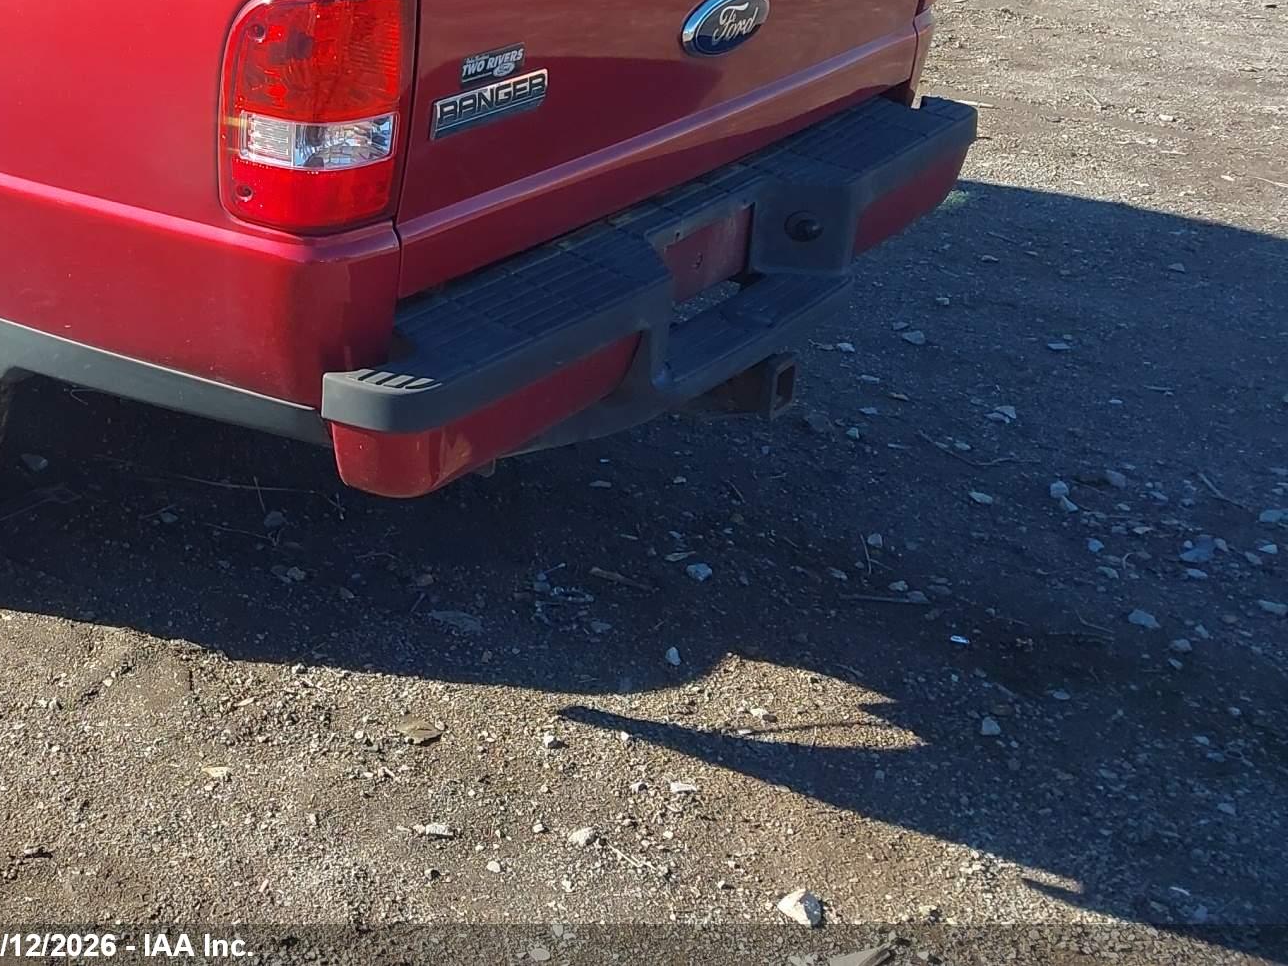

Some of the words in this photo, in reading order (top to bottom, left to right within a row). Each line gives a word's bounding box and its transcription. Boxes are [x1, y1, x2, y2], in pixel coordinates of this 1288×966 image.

[712, 2, 759, 45] Ford
[461, 61, 485, 76] TWO
[486, 49, 524, 70] RIVERS
[437, 73, 546, 122] RANGER
